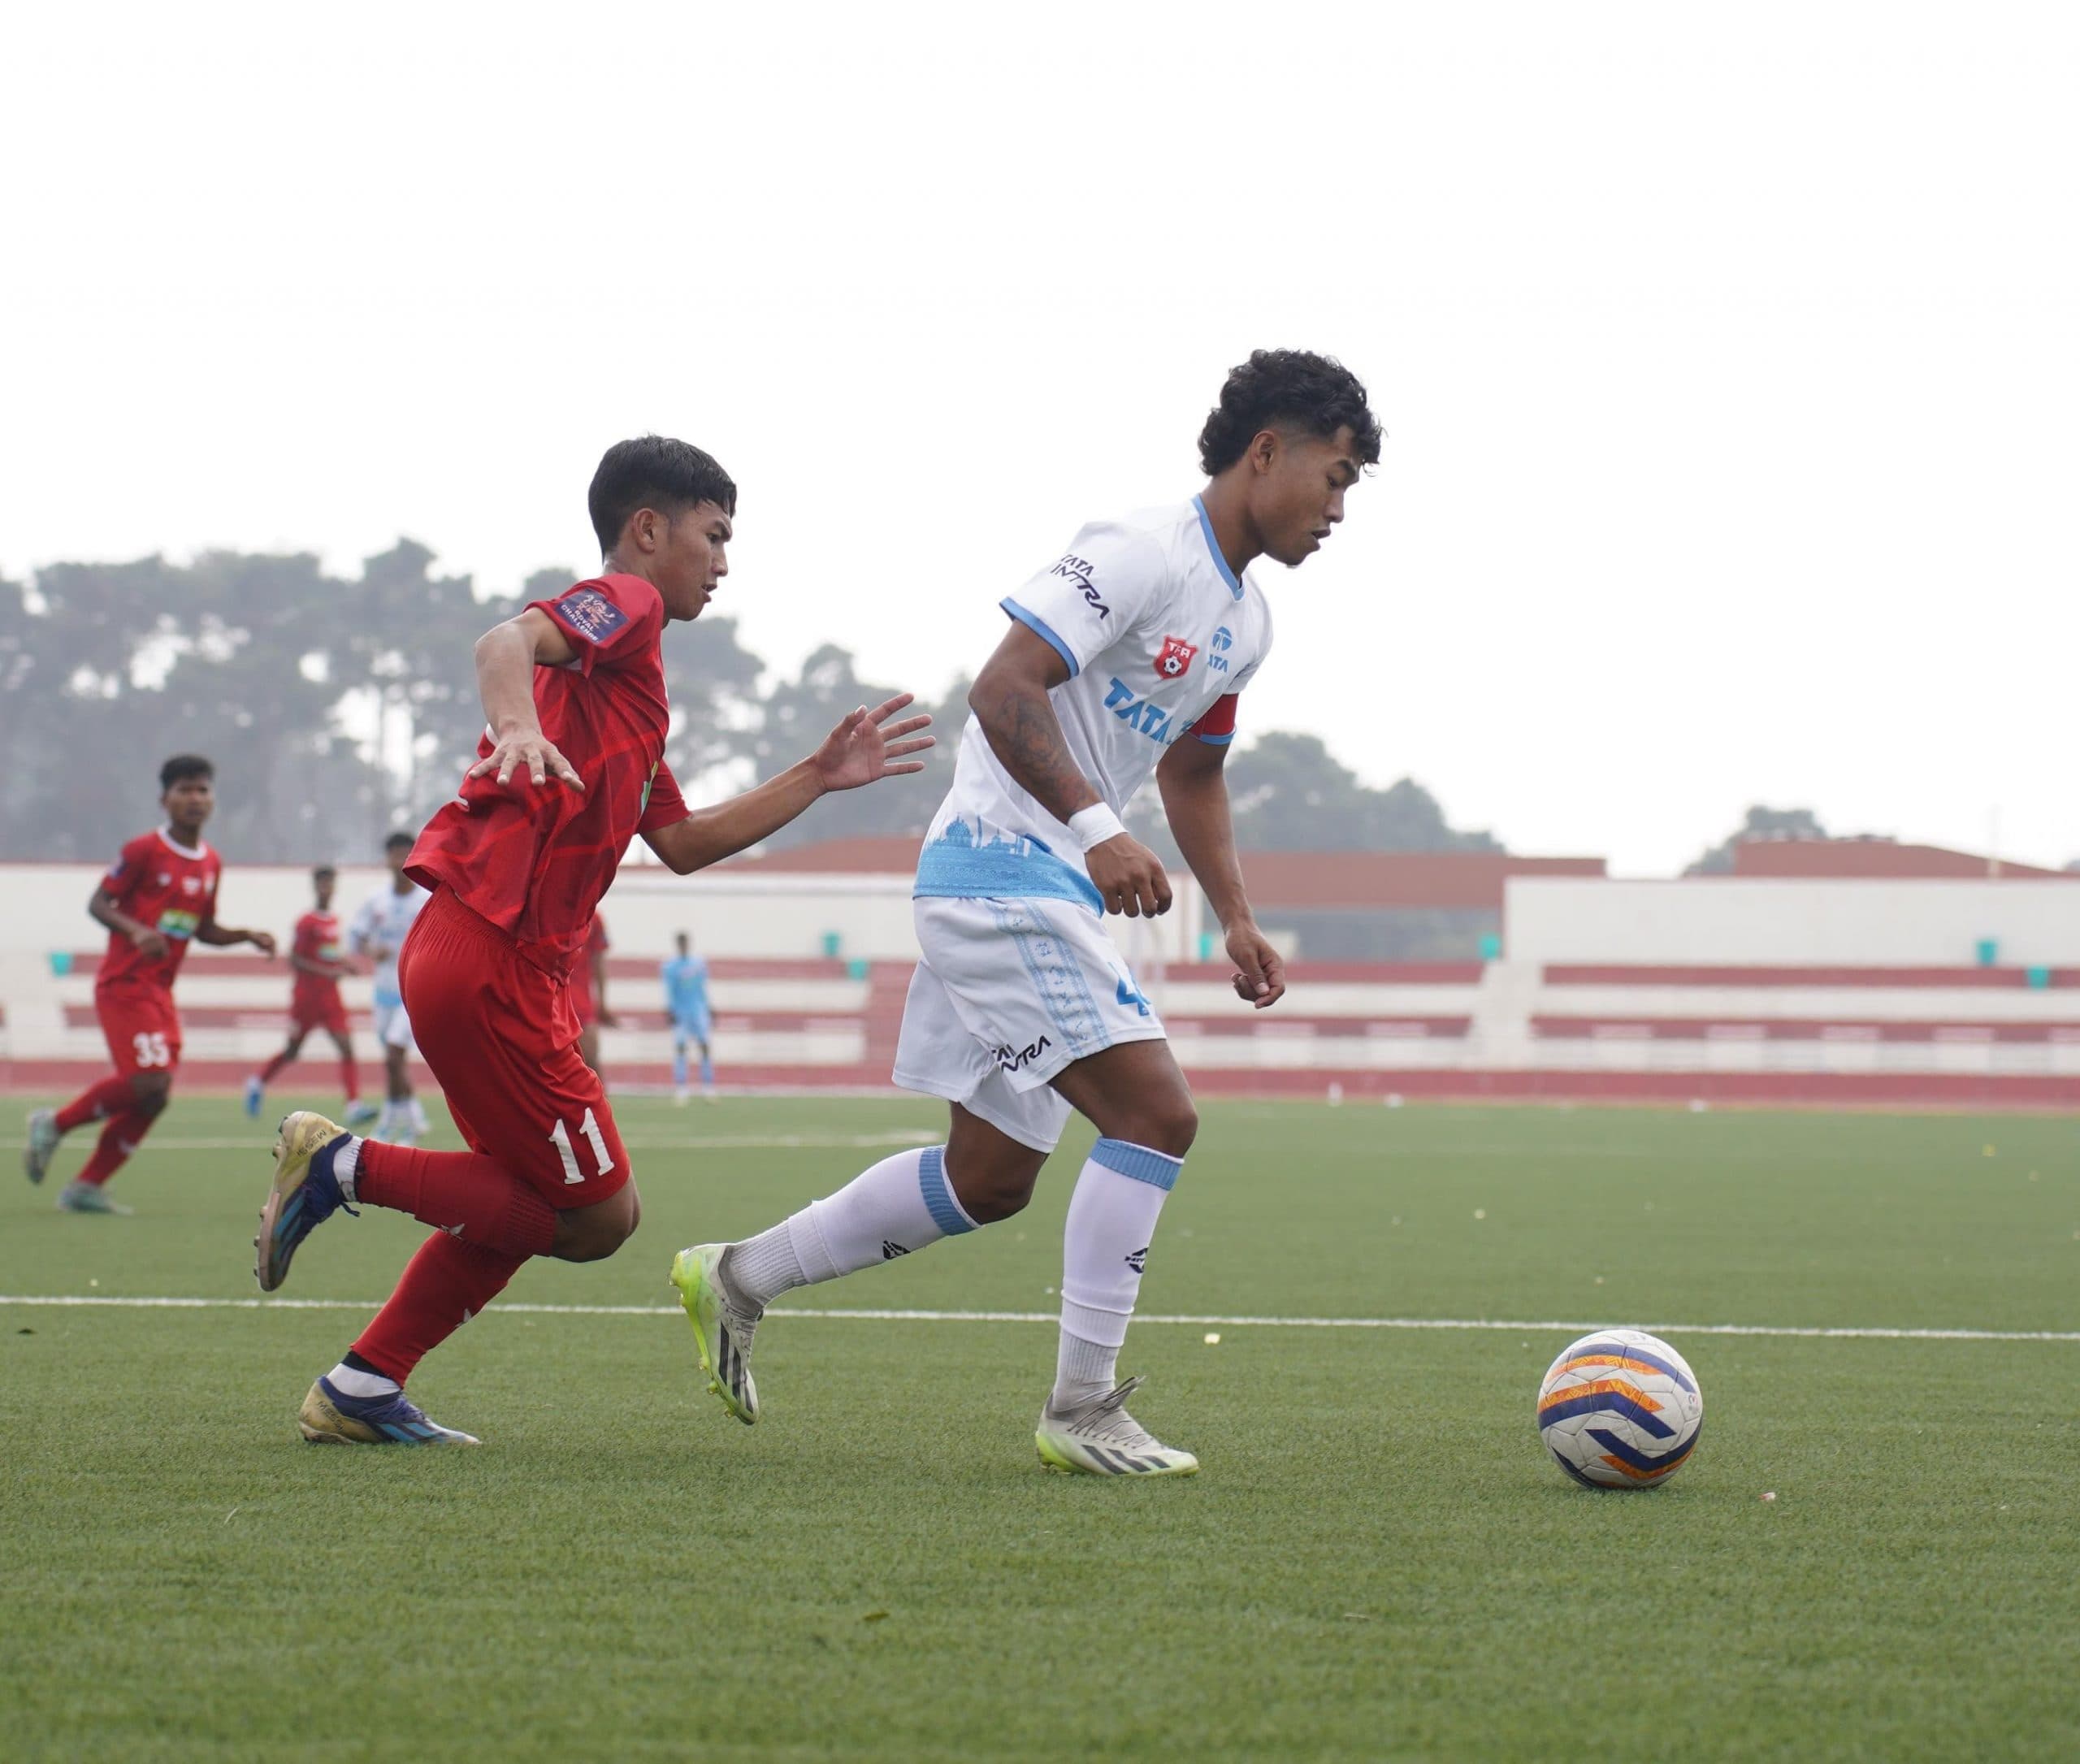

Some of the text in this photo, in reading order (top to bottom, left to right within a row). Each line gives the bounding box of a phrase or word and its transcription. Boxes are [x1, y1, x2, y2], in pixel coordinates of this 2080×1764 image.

[1050, 564, 1110, 620] INTRA
[1168, 642, 1191, 658] TFA
[1104, 677, 1172, 744] TATA
[133, 1032, 169, 1068] 35
[1001, 1035, 1051, 1073] NTRA
[548, 1107, 614, 1184] 11
